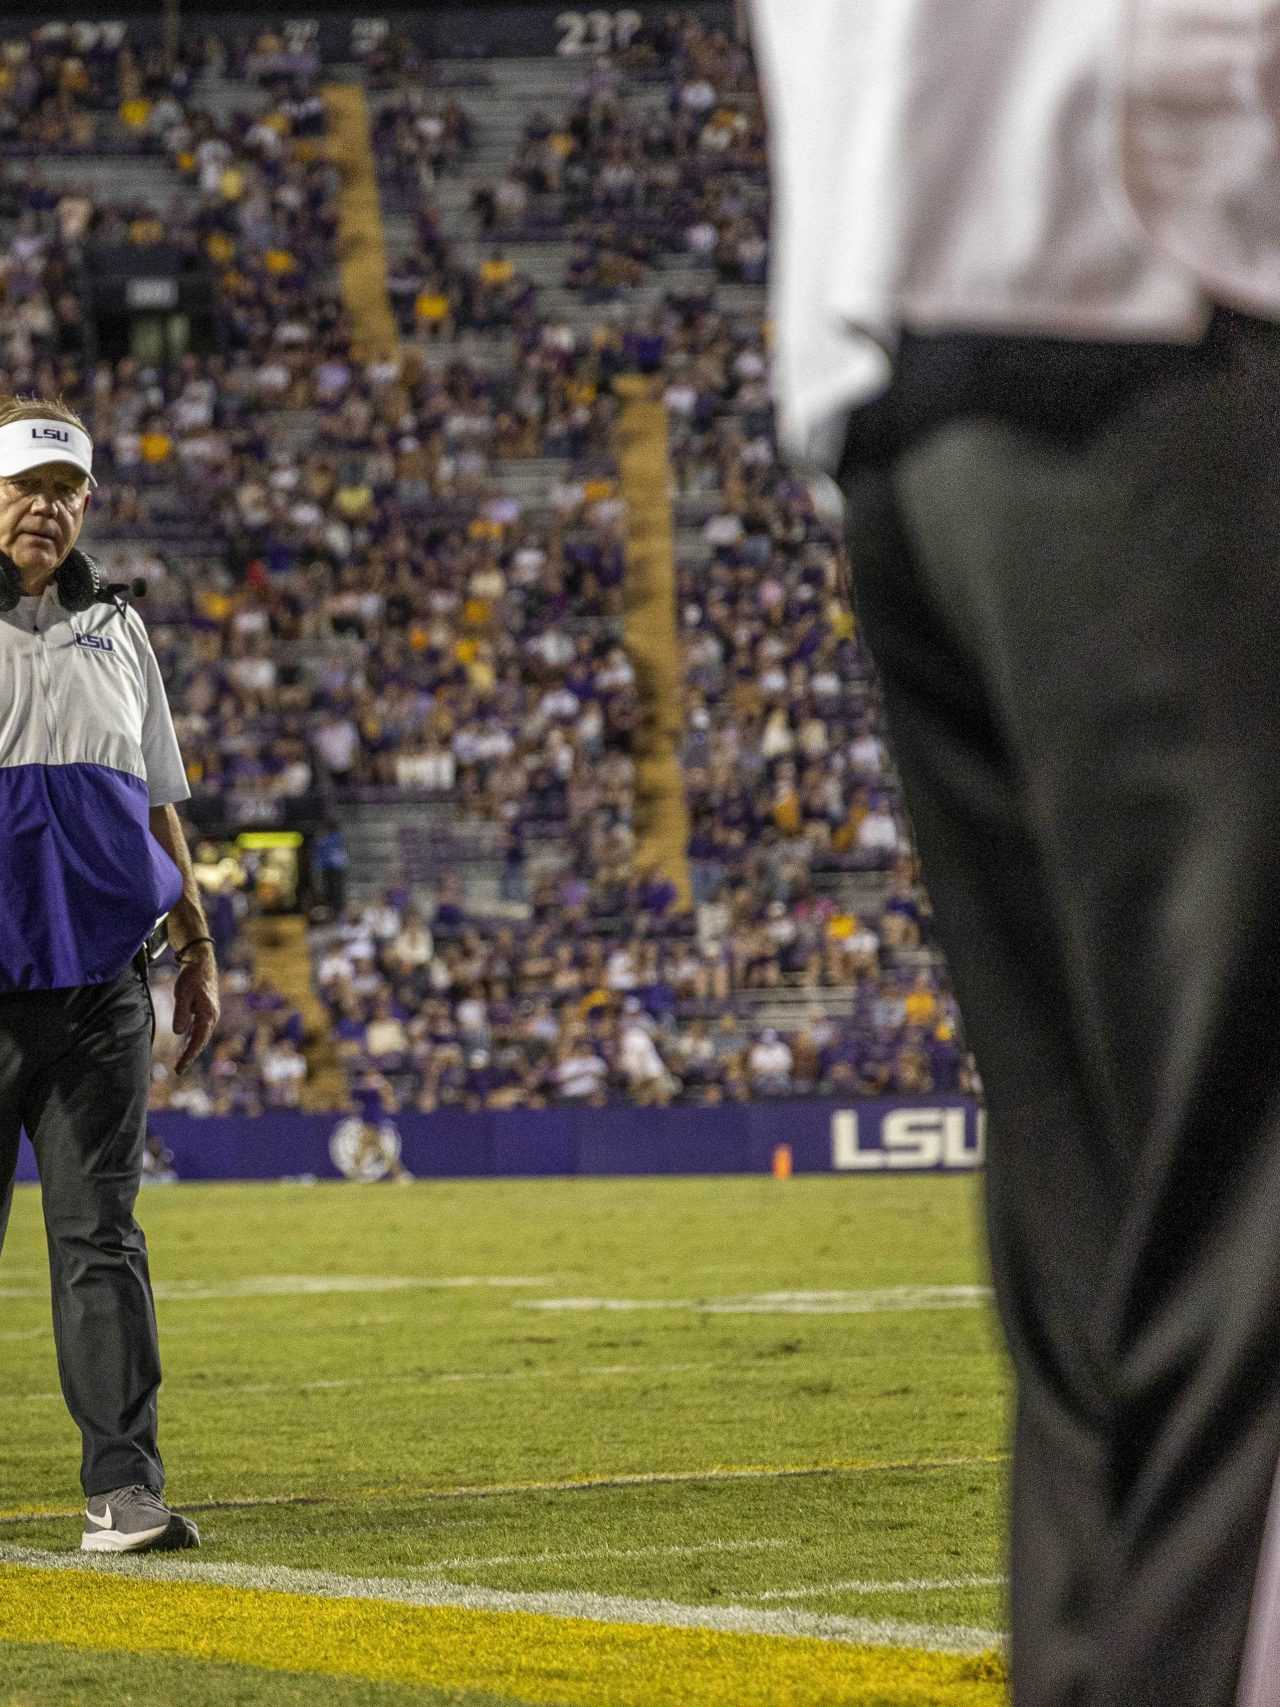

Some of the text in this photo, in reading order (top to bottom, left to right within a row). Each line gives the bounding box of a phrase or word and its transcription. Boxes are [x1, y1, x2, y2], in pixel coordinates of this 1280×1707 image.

[31, 428, 69, 442] LSU
[75, 632, 113, 651] LSU
[831, 1107, 986, 1169] LSU
